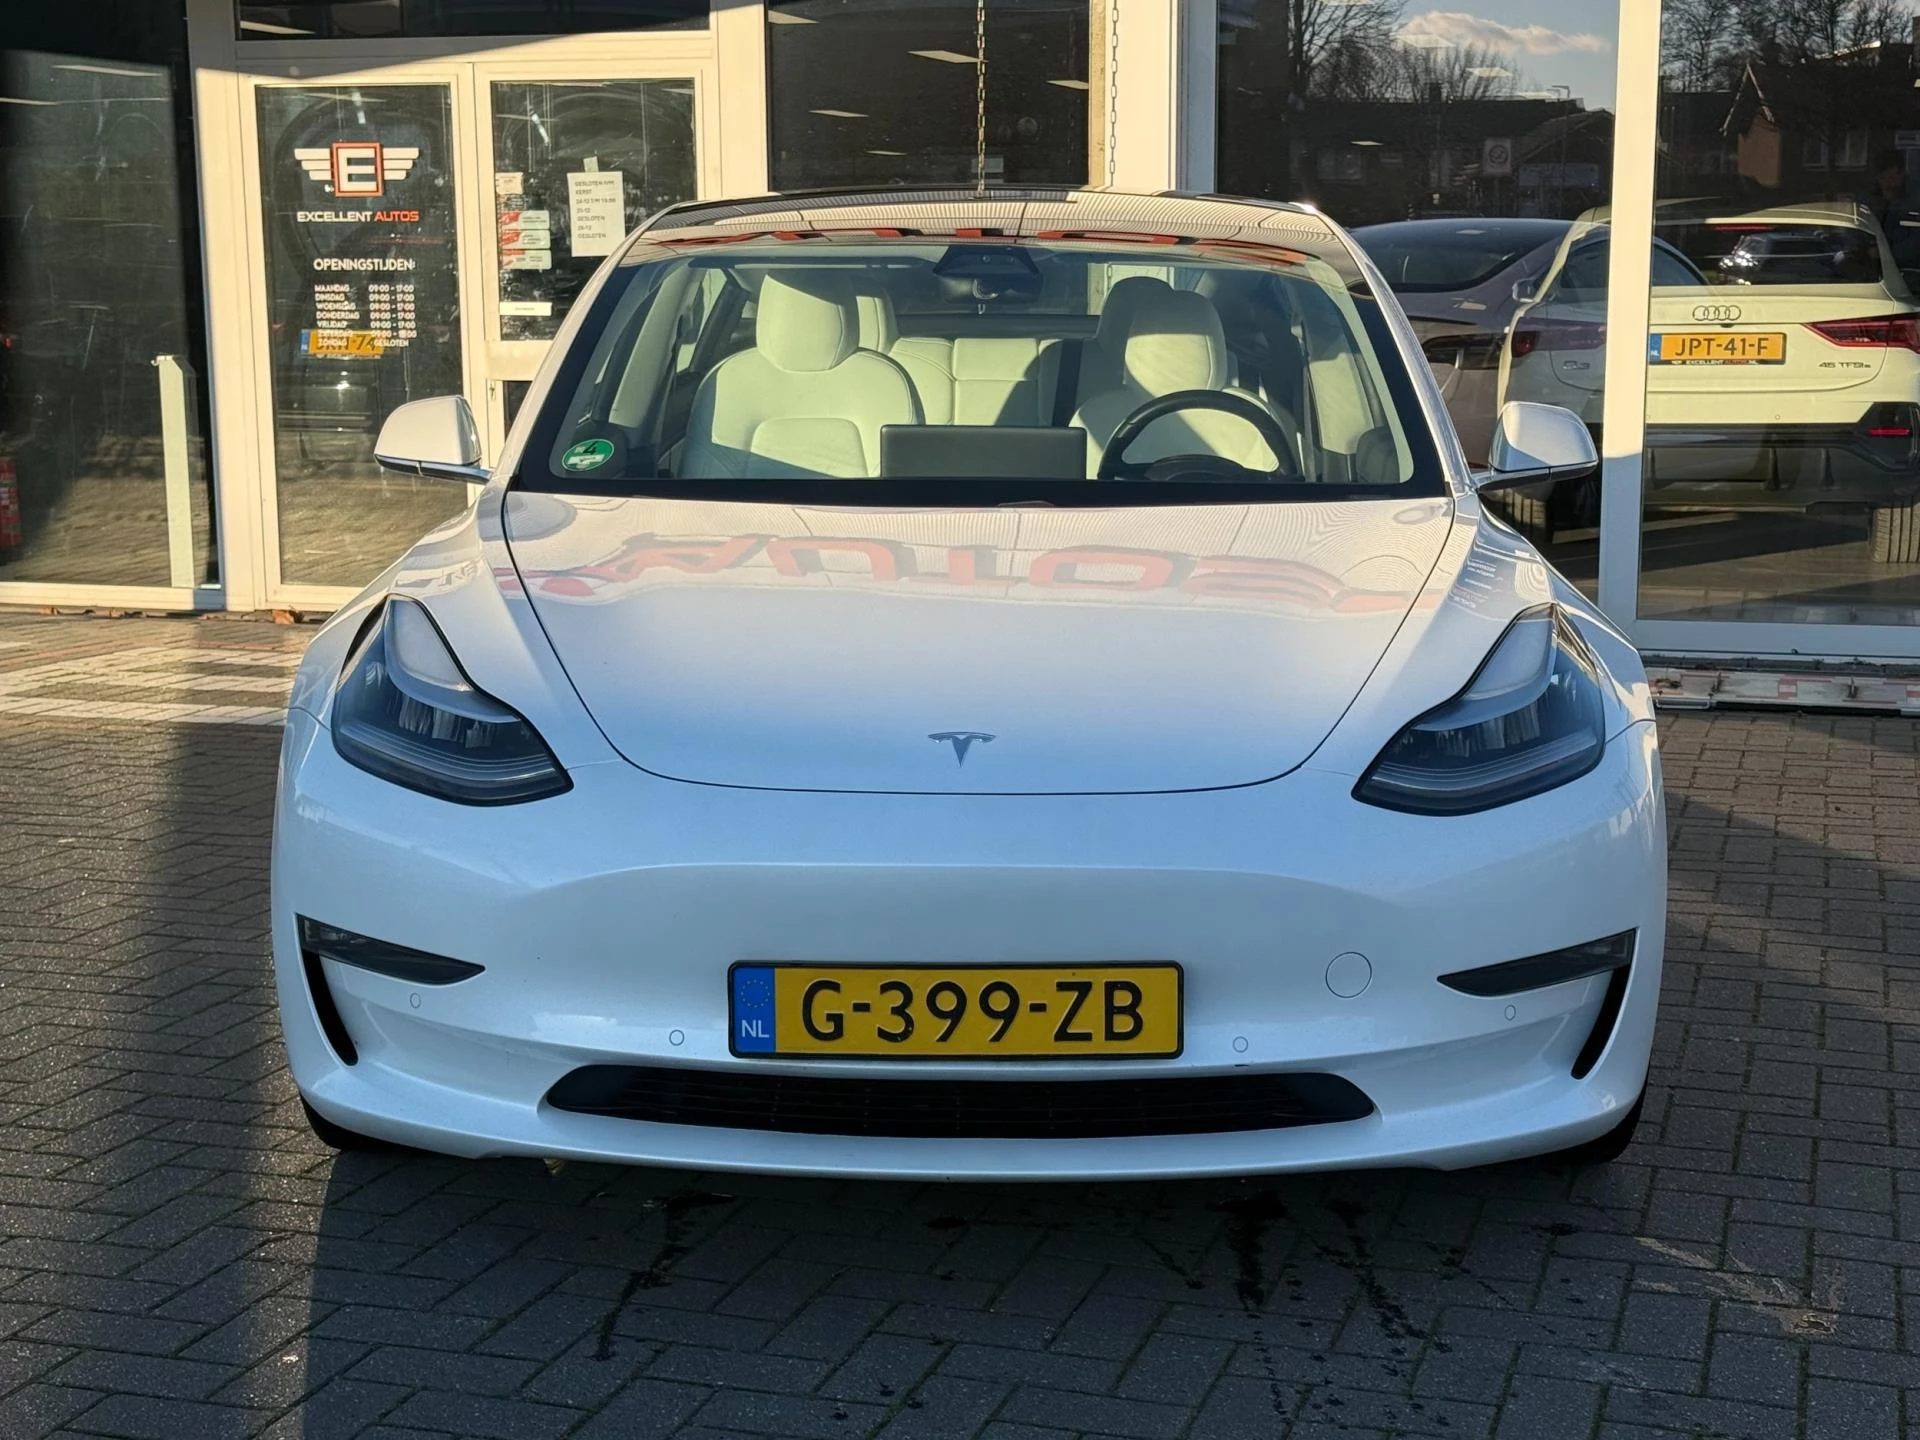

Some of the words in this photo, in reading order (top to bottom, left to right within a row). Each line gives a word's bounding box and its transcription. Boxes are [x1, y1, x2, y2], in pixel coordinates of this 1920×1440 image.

[337, 148, 379, 192] E
[297, 211, 372, 222] EXCELLENT
[374, 211, 420, 222] AUTOS
[313, 258, 416, 271] OPENINGSTIJDEN:
[314, 284, 350, 292] MAANDAG
[315, 293, 345, 301] DINSDAG
[316, 311, 360, 319] DONDERDAG
[1674, 337, 1769, 356] JPT-41-F
[583, 440, 597, 454] 4
[801, 979, 1144, 1042] G-399-ZB
[741, 1018, 770, 1039] NL
